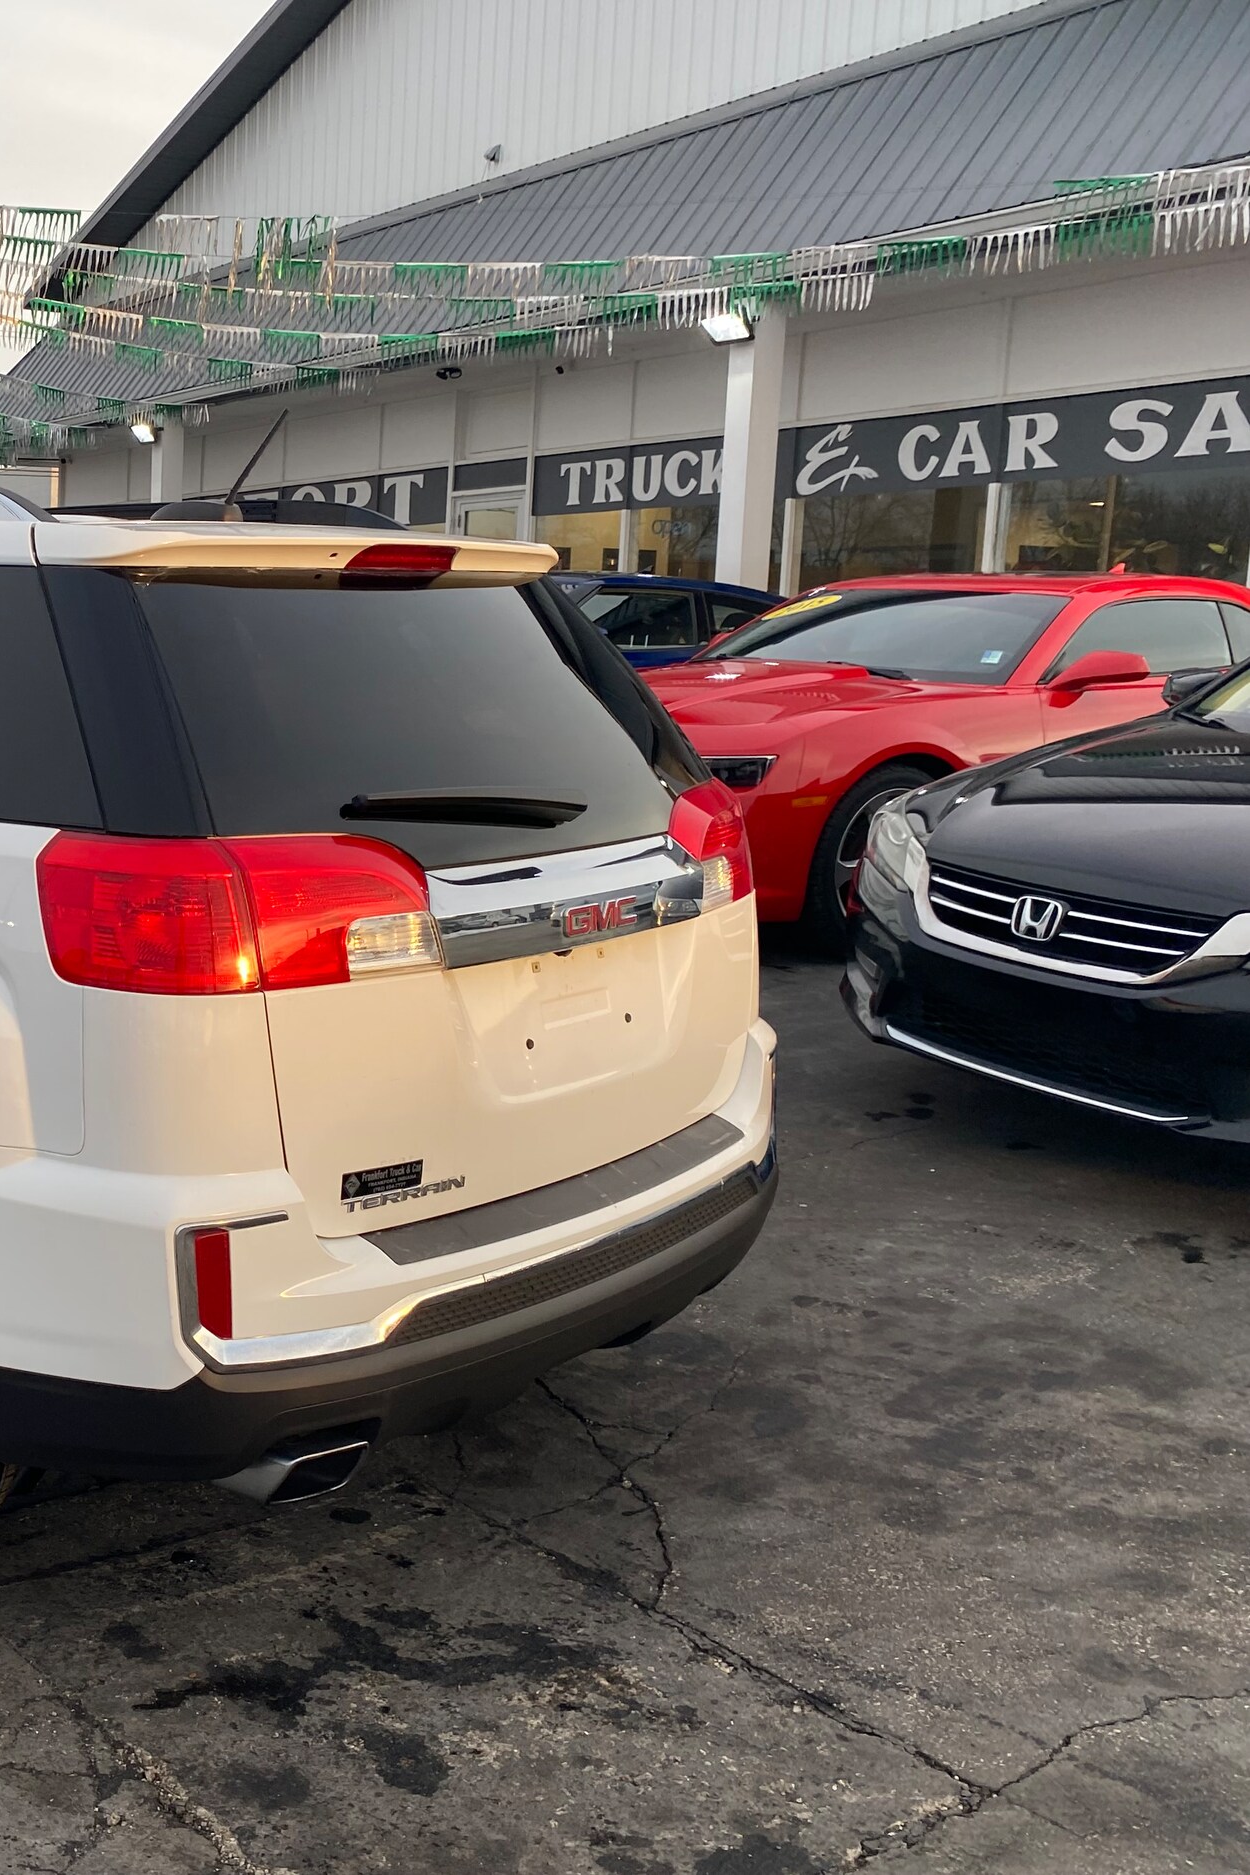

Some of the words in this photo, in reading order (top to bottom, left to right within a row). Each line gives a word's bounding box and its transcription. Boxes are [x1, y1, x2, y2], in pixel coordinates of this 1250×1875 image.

[560, 449, 724, 506] TRUCK
[897, 411, 1059, 482] CAR
[1104, 390, 1250, 462] SA
[566, 894, 639, 938] GMC
[362, 1169, 389, 1181] Frankfort
[389, 1166, 405, 1178] Truck
[341, 1175, 466, 1214] TERRAIN
